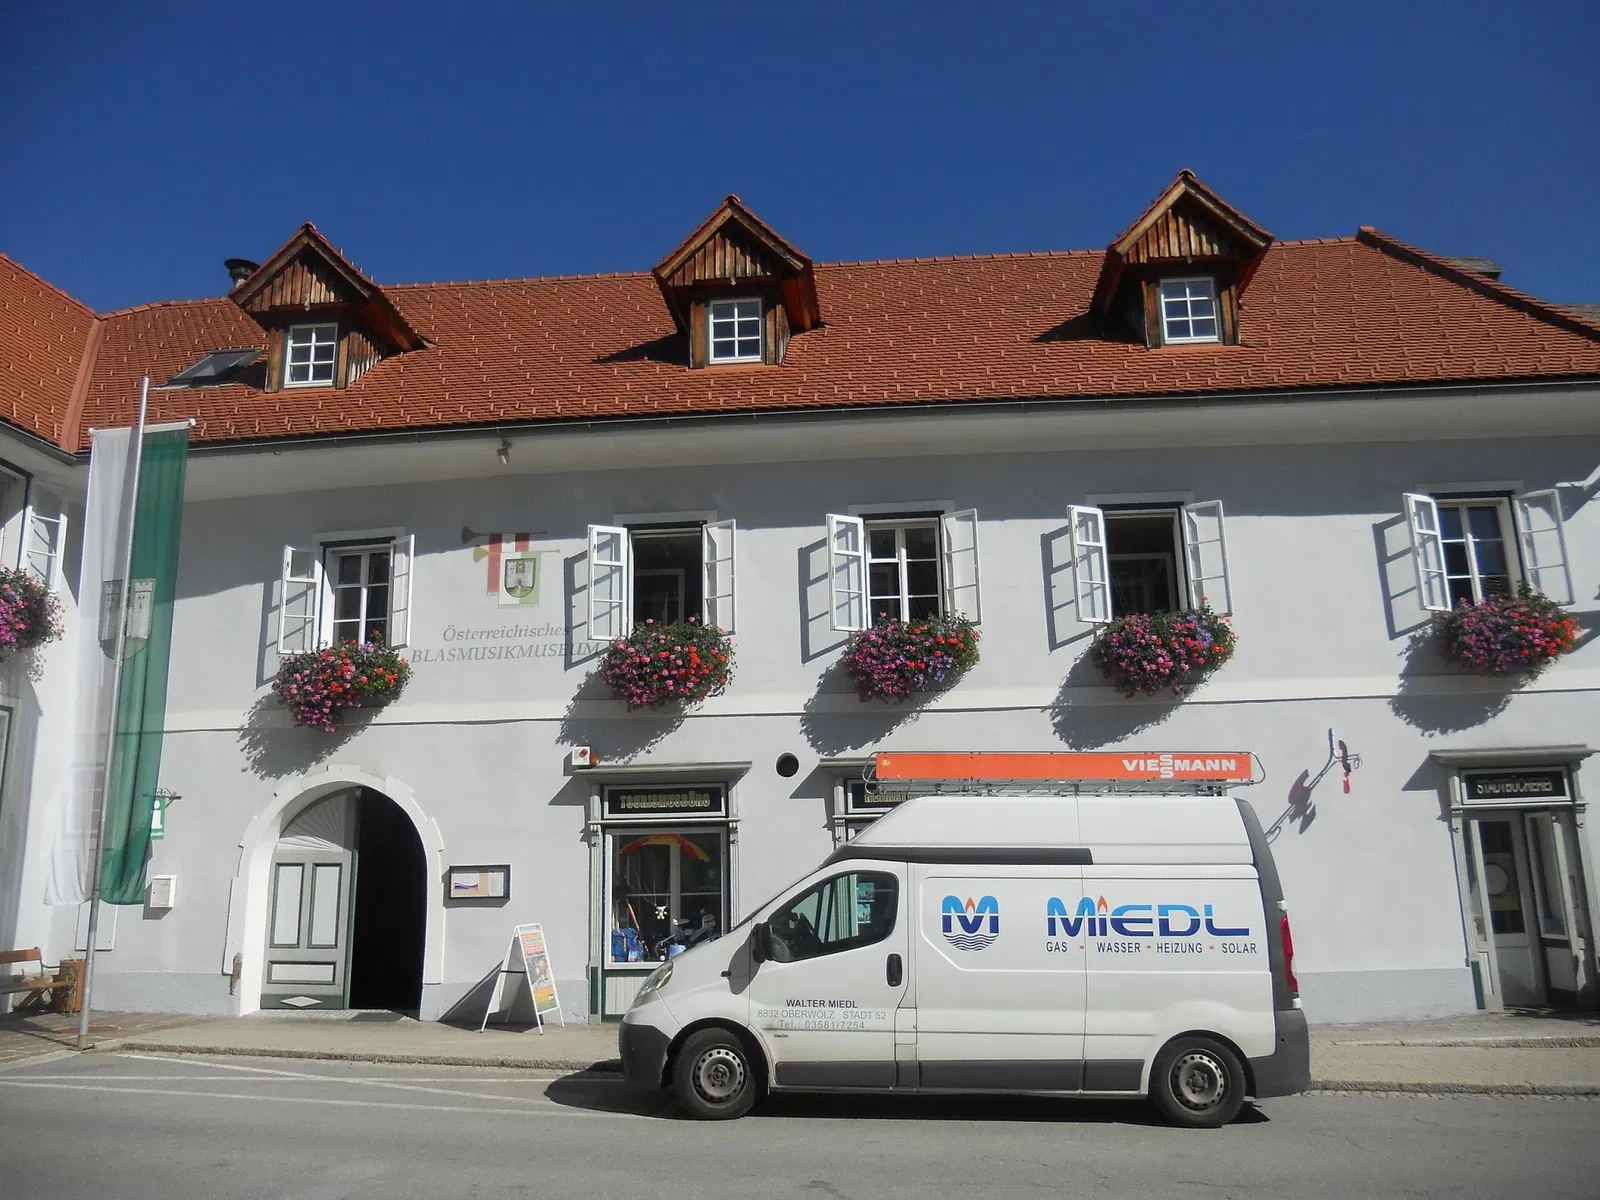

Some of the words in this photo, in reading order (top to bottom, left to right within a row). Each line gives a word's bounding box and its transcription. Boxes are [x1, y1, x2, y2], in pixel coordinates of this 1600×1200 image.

[443, 623, 572, 642] Österreichisches
[411, 642, 600, 664] BLASMUSIKMUSEUM
[1122, 754, 1236, 778] VIESSMANN
[620, 791, 710, 809] TOURISMUSBÜRO
[1046, 941, 1068, 953] GAS
[1097, 942, 1141, 954] WASSER
[1156, 942, 1203, 954] HEIZUNG
[1221, 942, 1257, 954] SOLAR
[786, 999, 826, 1008] WALTER
[828, 1000, 858, 1009] MIEDL
[757, 1009, 779, 1018] 8832
[842, 1010, 873, 1020] STADT
[875, 1011, 887, 1020] 52
[804, 1020, 865, 1030] 03581/7254
